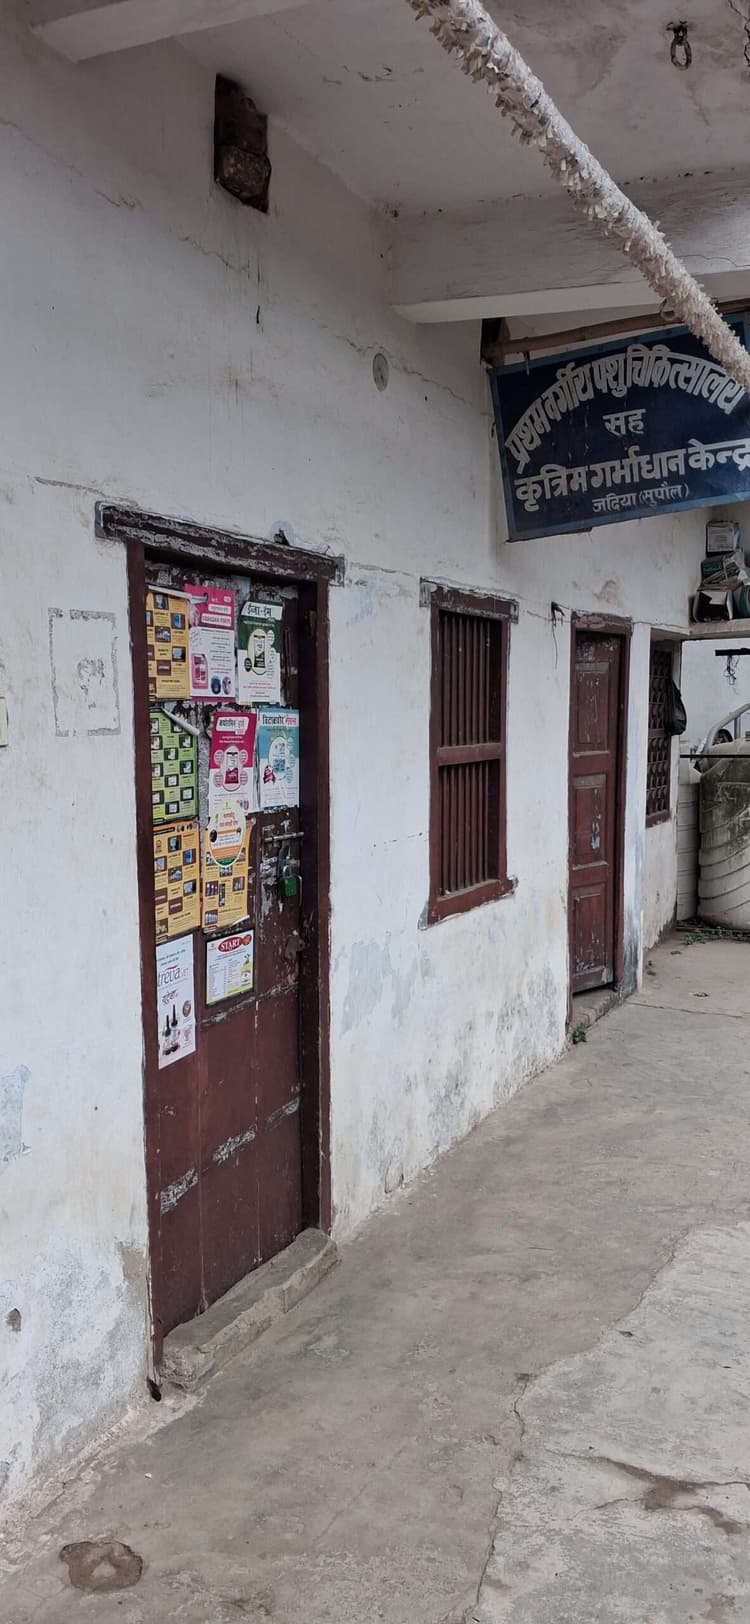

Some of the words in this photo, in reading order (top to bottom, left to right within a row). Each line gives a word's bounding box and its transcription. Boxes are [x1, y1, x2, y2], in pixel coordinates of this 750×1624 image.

[504, 397, 551, 475] प्रथम
[603, 408, 646, 436] सह
[514, 464, 588, 512] कृत्रिम
[592, 493, 637, 513] जदिया
[220, 939, 241, 951] START
